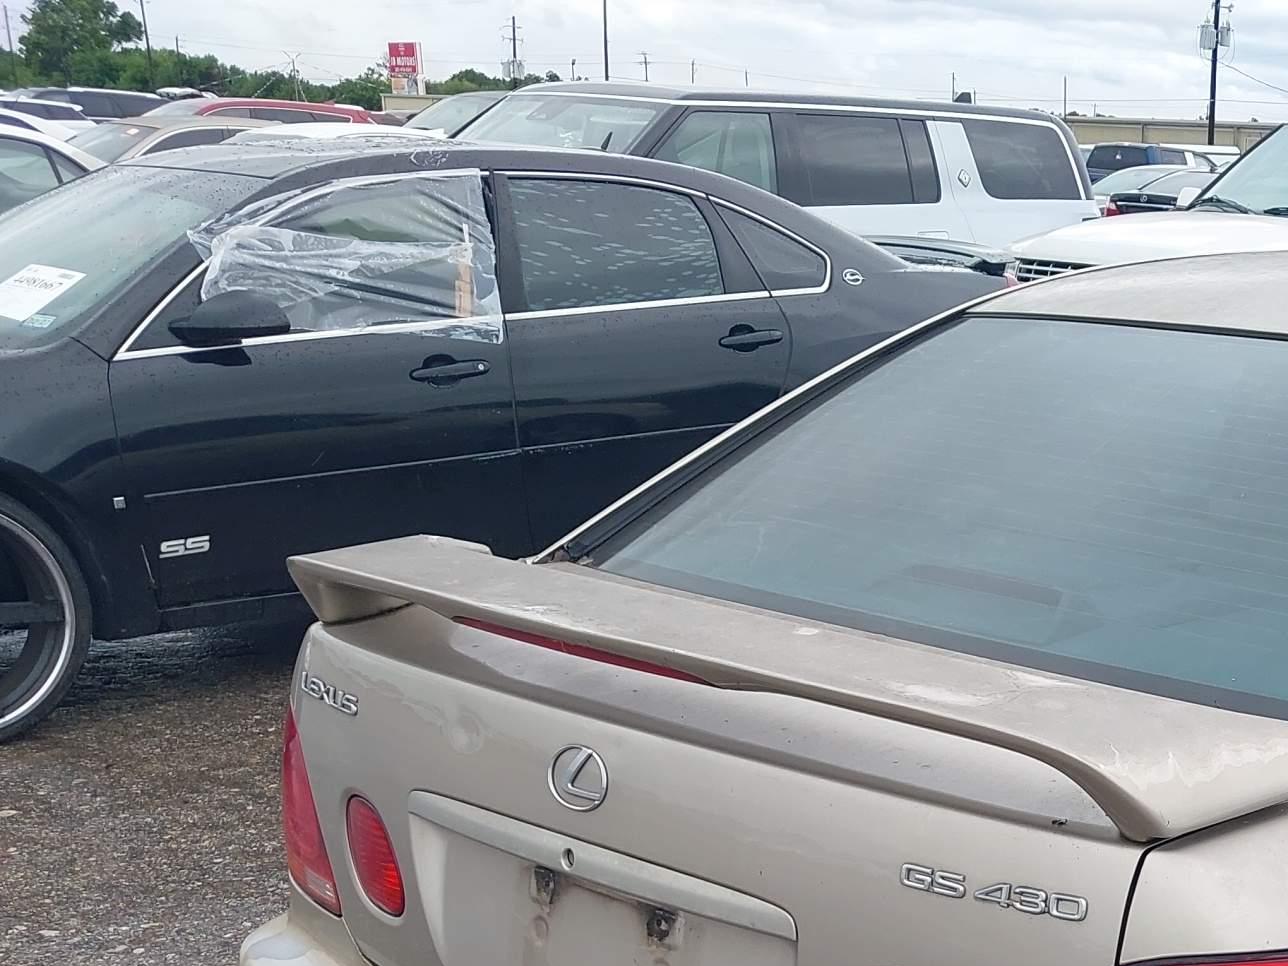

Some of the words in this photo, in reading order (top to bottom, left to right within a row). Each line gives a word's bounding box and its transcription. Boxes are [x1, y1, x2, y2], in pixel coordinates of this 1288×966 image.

[159, 535, 211, 559] SS
[301, 671, 359, 716] LEXUS
[900, 862, 966, 899] GS
[973, 882, 1089, 922] 430
